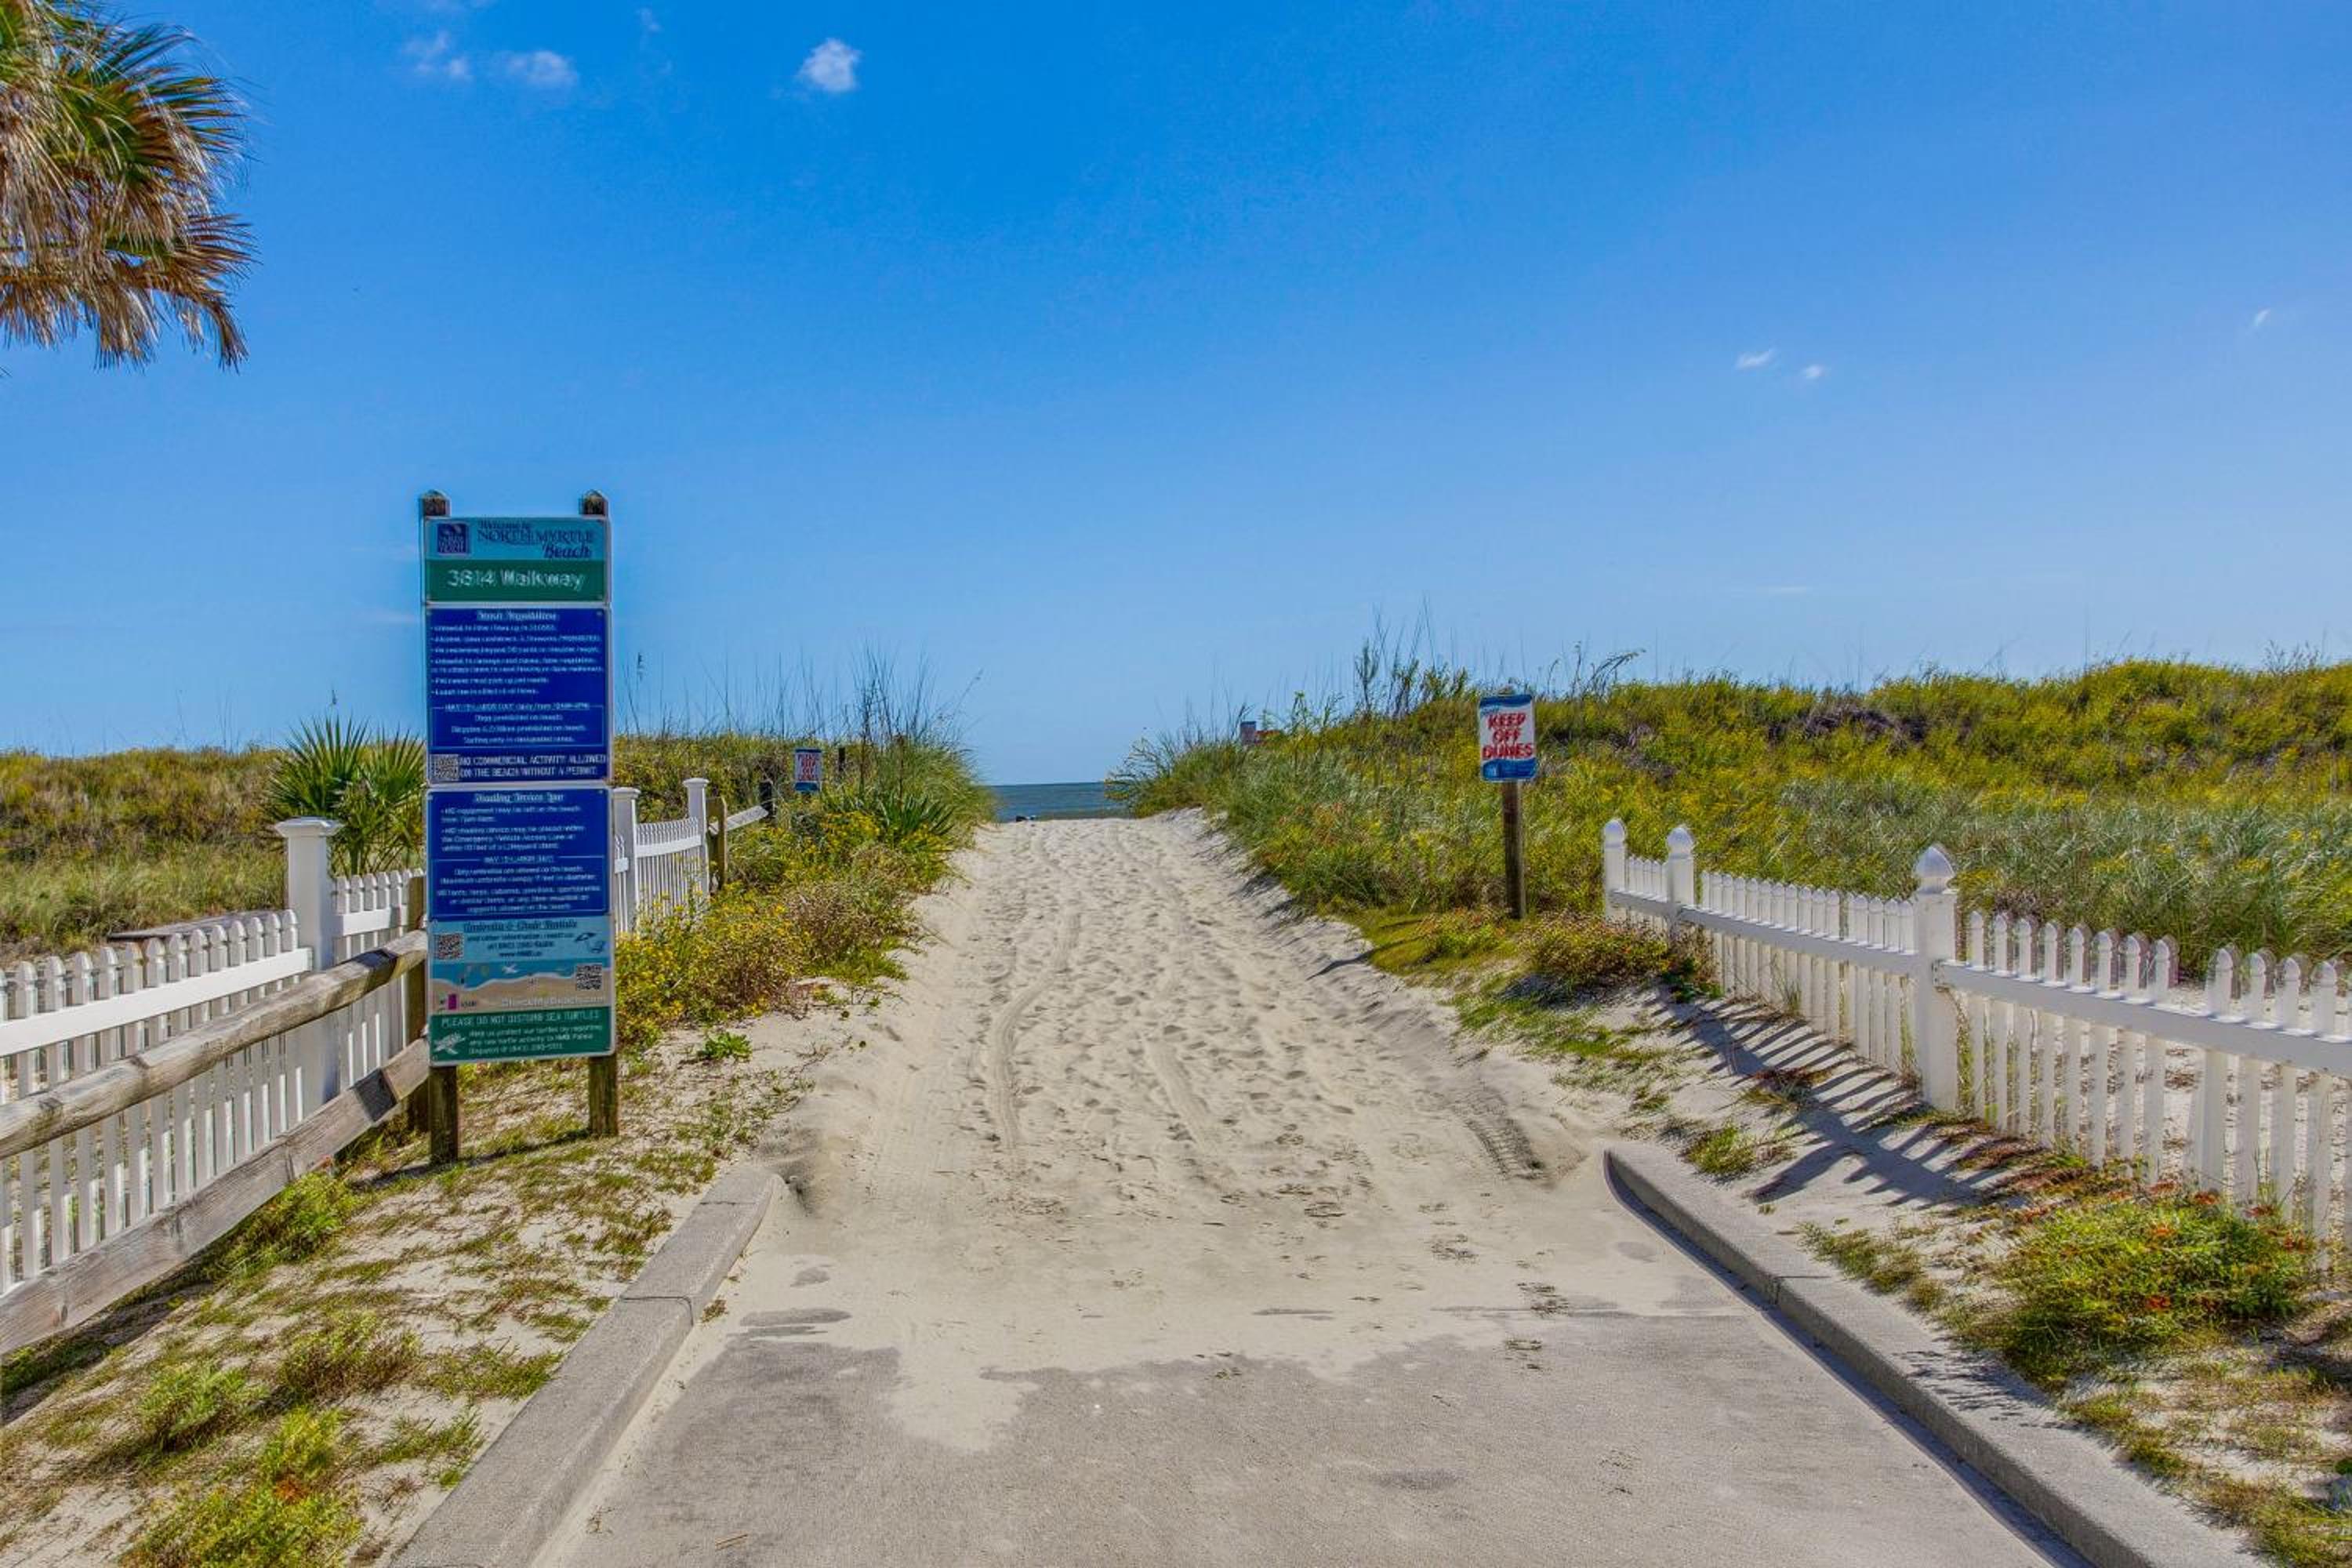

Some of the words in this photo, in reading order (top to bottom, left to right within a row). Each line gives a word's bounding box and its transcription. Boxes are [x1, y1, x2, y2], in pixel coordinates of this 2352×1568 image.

[477, 530, 531, 543] NORTH
[535, 530, 594, 543] MYRTLE
[543, 541, 593, 558] Beach
[499, 568, 585, 591] Walkway
[1487, 713, 1526, 730] KEEP
[1492, 728, 1523, 743] OFF
[1483, 742, 1533, 759] DUNES
[459, 757, 470, 765] NO
[474, 756, 527, 765] COMMERCIAL
[529, 755, 565, 764] ACTIVITY
[569, 753, 605, 764] ALLOWED
[474, 768, 490, 777] THE
[492, 768, 519, 776] BEACH
[520, 767, 555, 775] WITHOUT
[441, 1018, 474, 1028] PLEASE
